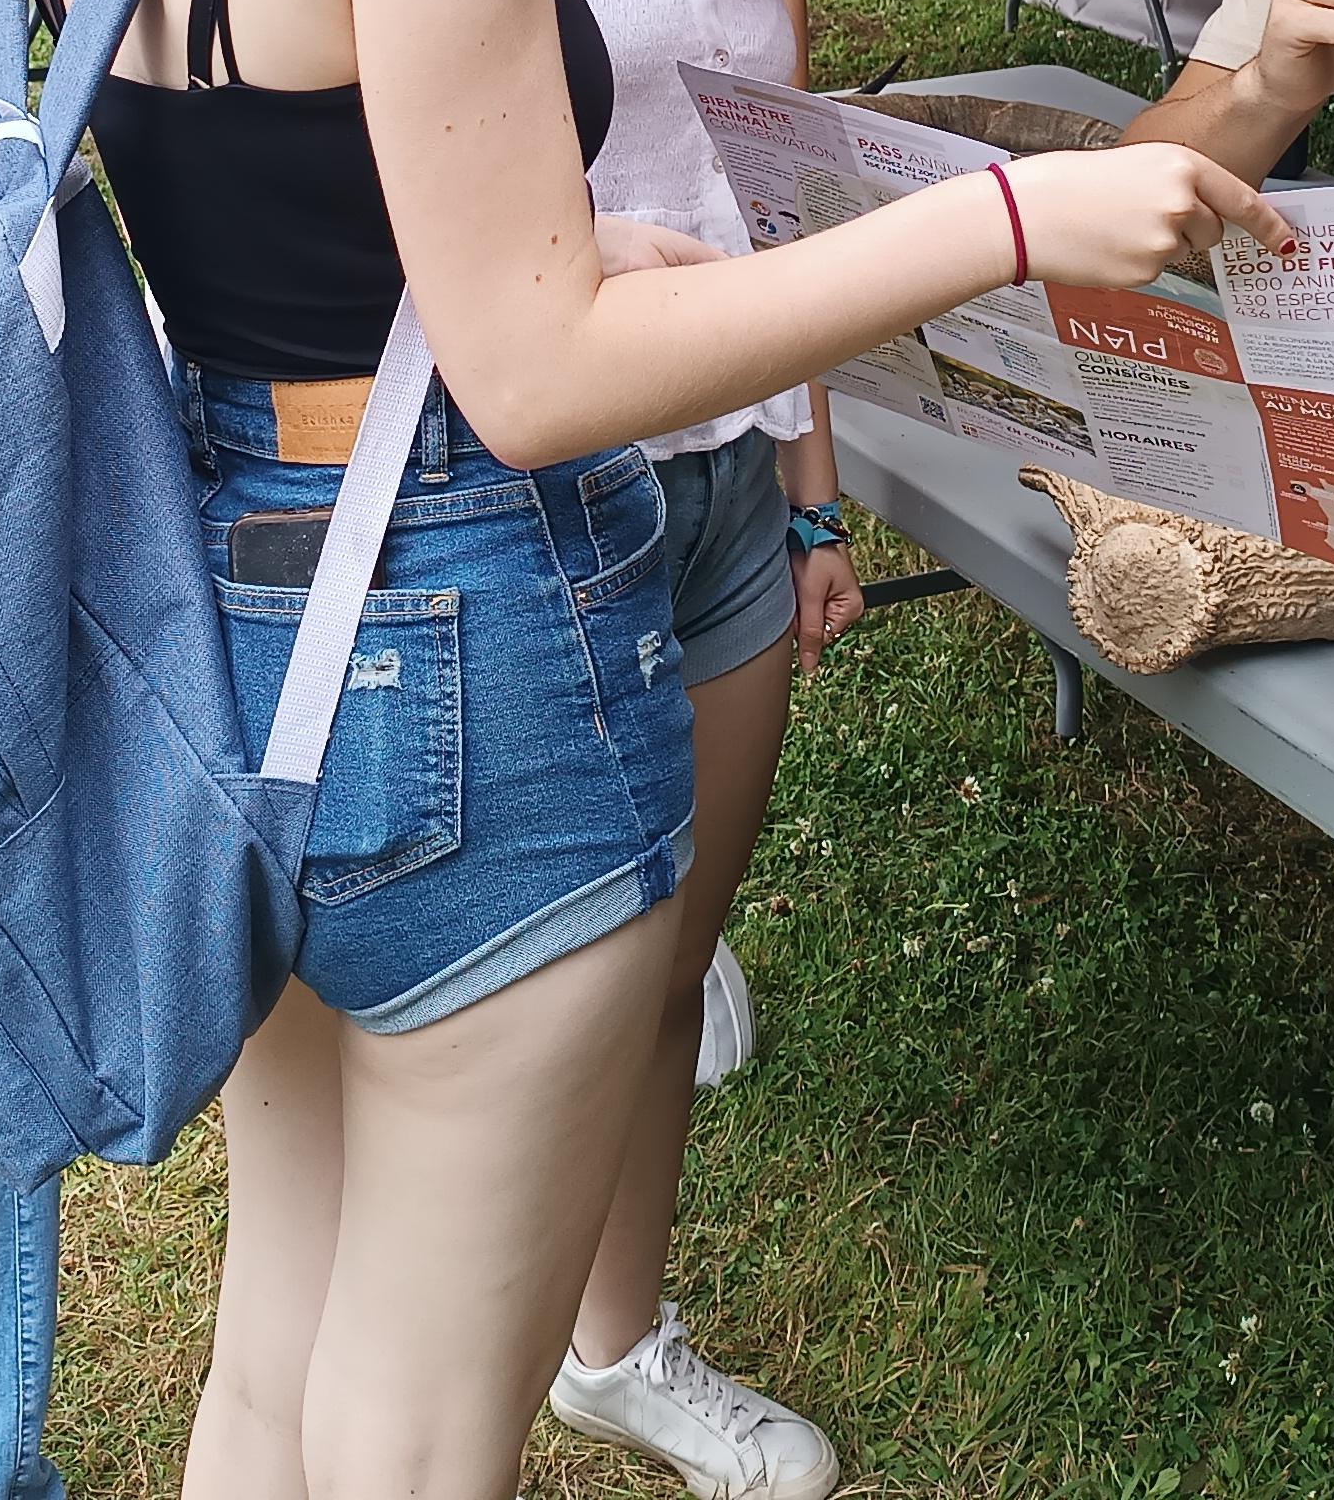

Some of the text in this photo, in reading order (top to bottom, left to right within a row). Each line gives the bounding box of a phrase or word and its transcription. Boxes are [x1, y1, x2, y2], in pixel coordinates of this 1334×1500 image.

[698, 94, 792, 125] BIEN-ÊTRE
[778, 124, 796, 136] ET
[857, 137, 973, 175] PASS ANNUE
[1223, 248, 1248, 262] LE
[1257, 241, 1311, 258] PS
[1224, 261, 1273, 276] ZOO
[1282, 258, 1310, 272] DE
[1232, 293, 1267, 307] 130
[1235, 306, 1270, 320] 436
[1067, 317, 1167, 360] PLAN
[1075, 350, 1173, 376] QUELQUES
[1078, 364, 1191, 389] CONSIGNES
[1266, 400, 1292, 412] AU
